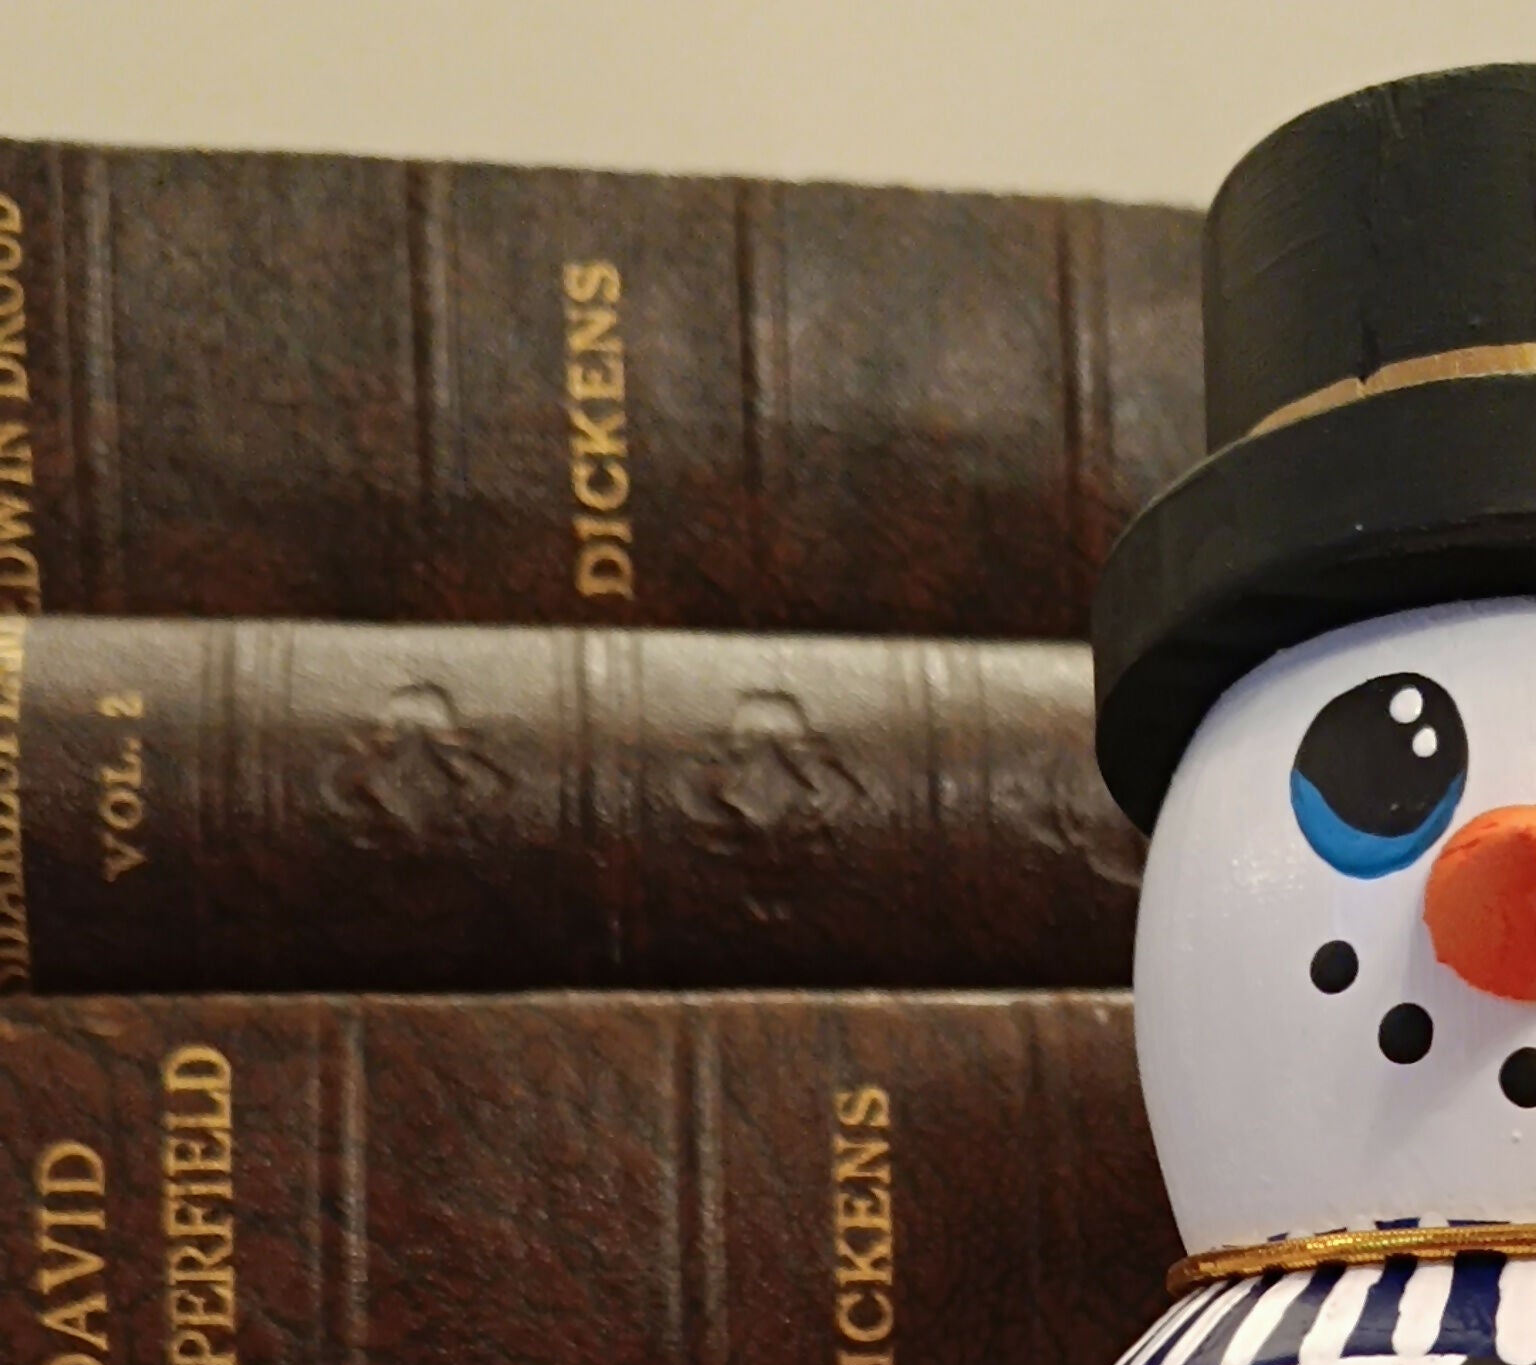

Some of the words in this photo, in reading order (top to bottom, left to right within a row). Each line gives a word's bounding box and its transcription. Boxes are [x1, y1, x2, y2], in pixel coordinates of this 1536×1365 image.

[0, 414, 41, 616] DWIN
[563, 259, 632, 600] DICKENS
[102, 688, 145, 718] 2
[102, 736, 149, 883] VOL.
